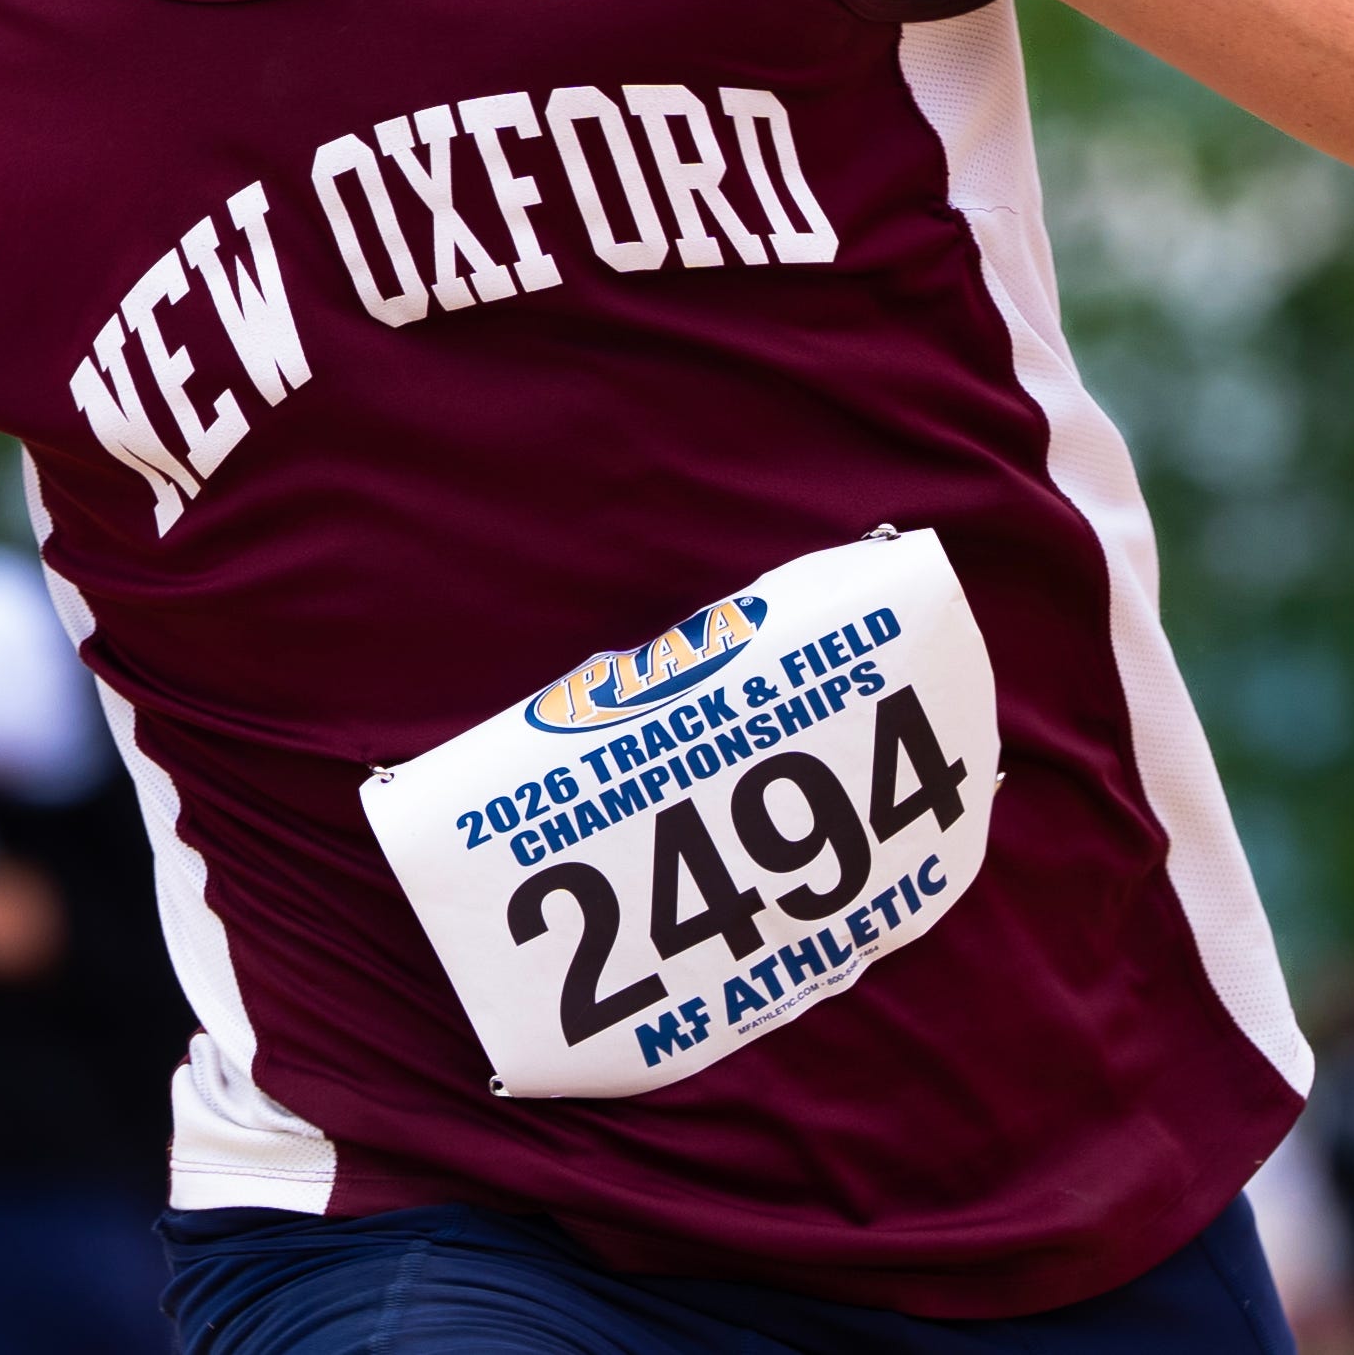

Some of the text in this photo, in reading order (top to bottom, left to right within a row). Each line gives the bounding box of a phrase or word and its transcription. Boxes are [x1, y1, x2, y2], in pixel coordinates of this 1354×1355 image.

[70, 85, 839, 538] NEW OXFORD
[456, 607, 902, 850] 2026 TRACK & FIELD
[510, 660, 886, 867] CHAMPIONSHIPS
[563, 599, 758, 726] PIAA
[507, 684, 968, 1047] 2494
[634, 854, 947, 1067] MF ATHLETIC
[738, 982, 820, 1035] MFATHLETIC.COM
